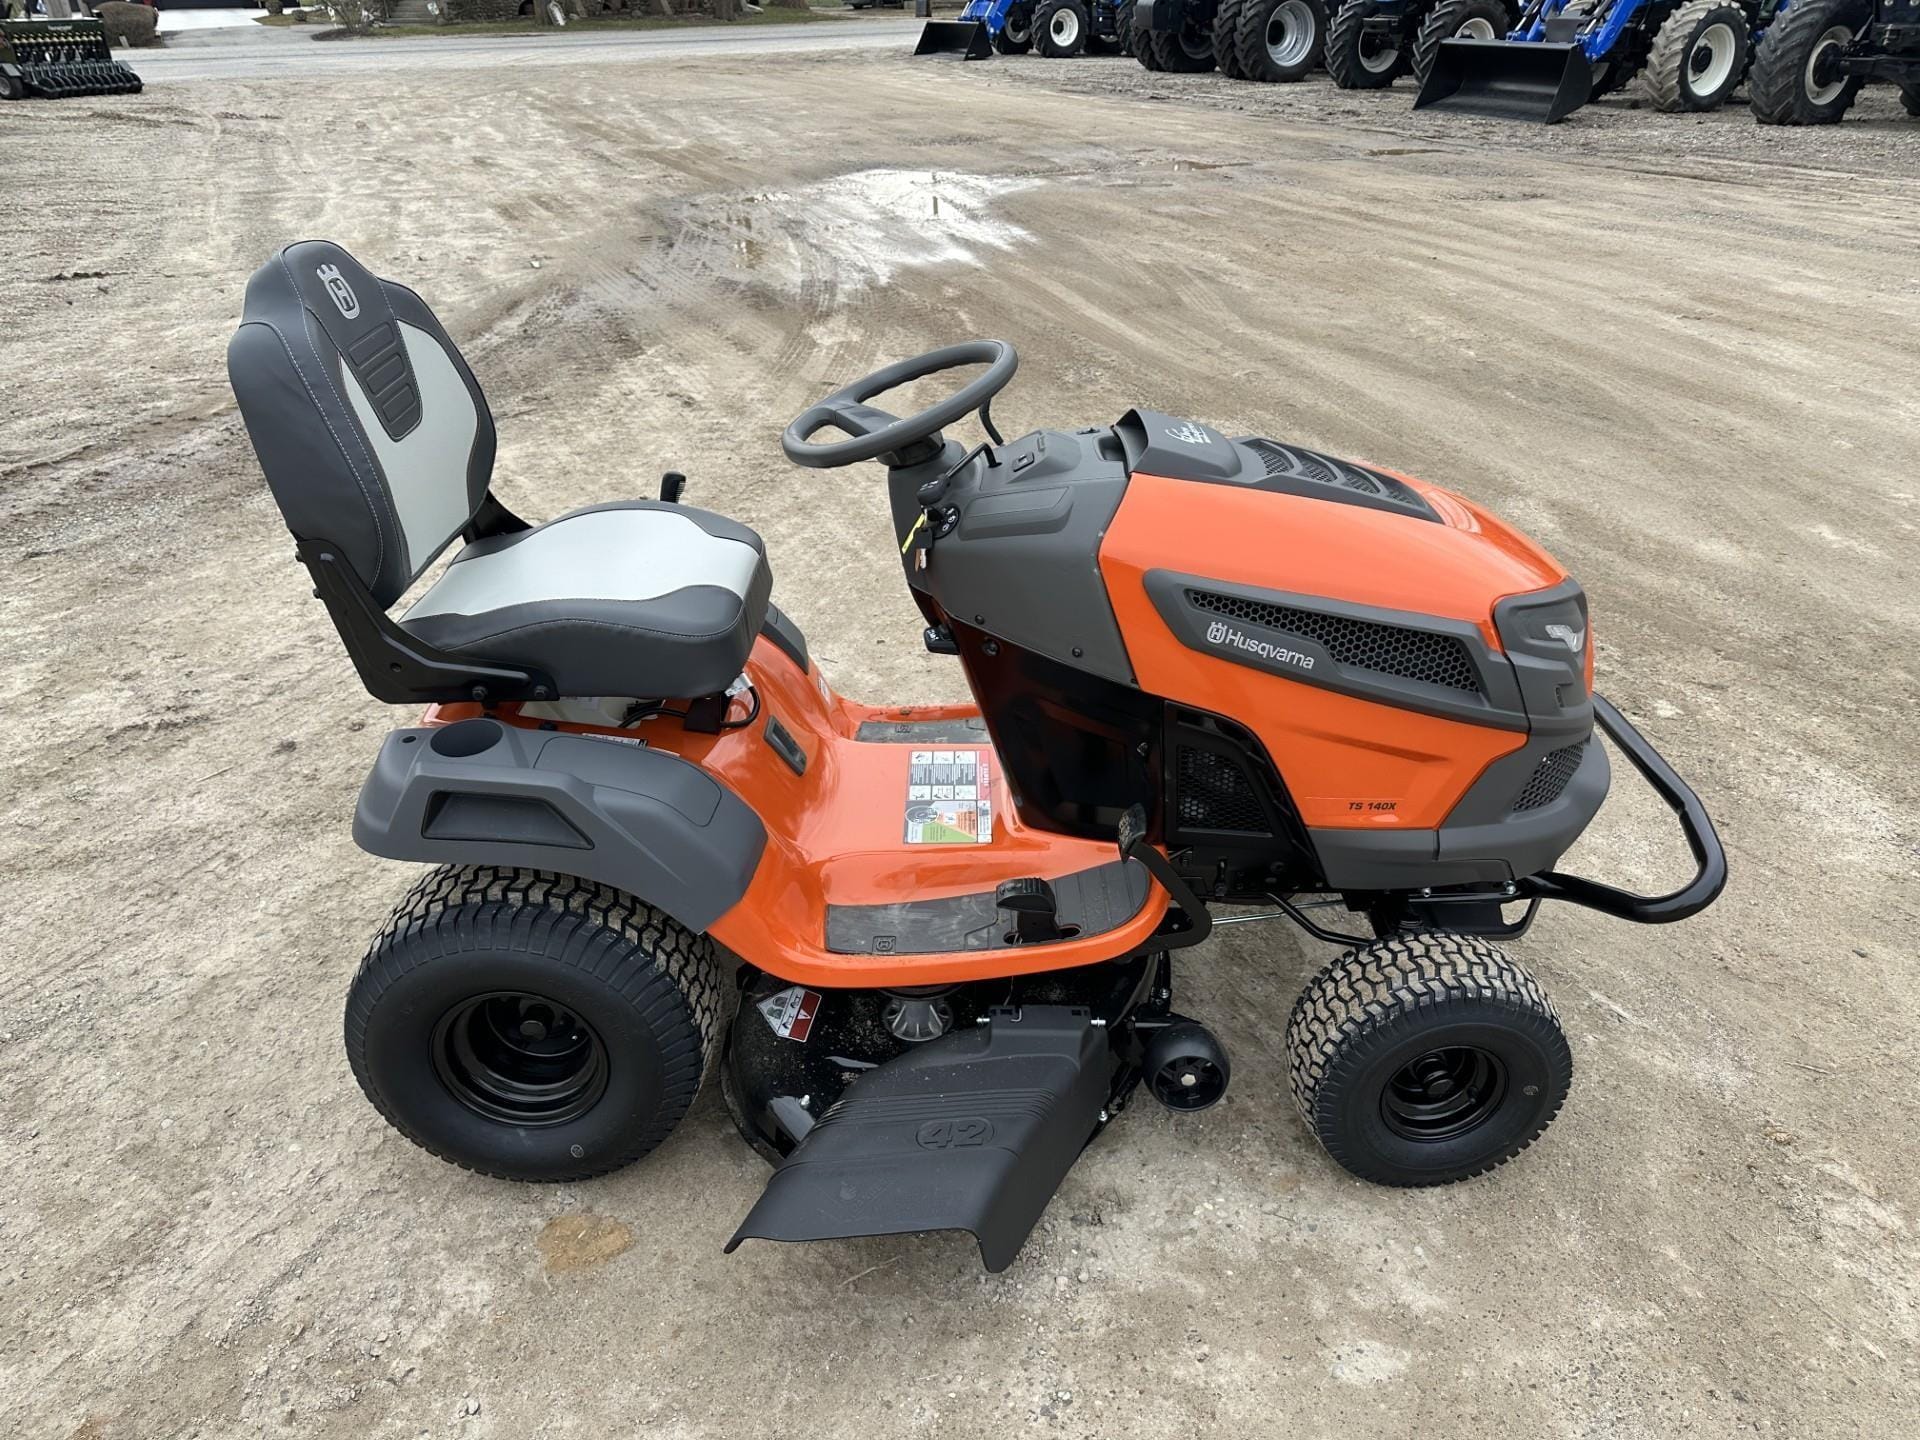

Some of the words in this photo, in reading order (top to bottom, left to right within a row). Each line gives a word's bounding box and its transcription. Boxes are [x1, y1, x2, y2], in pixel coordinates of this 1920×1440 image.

[1224, 628, 1315, 670] Husqvarna
[1348, 801, 1364, 811] TS
[1367, 801, 1397, 811] 140X
[922, 1121, 987, 1149] 42
